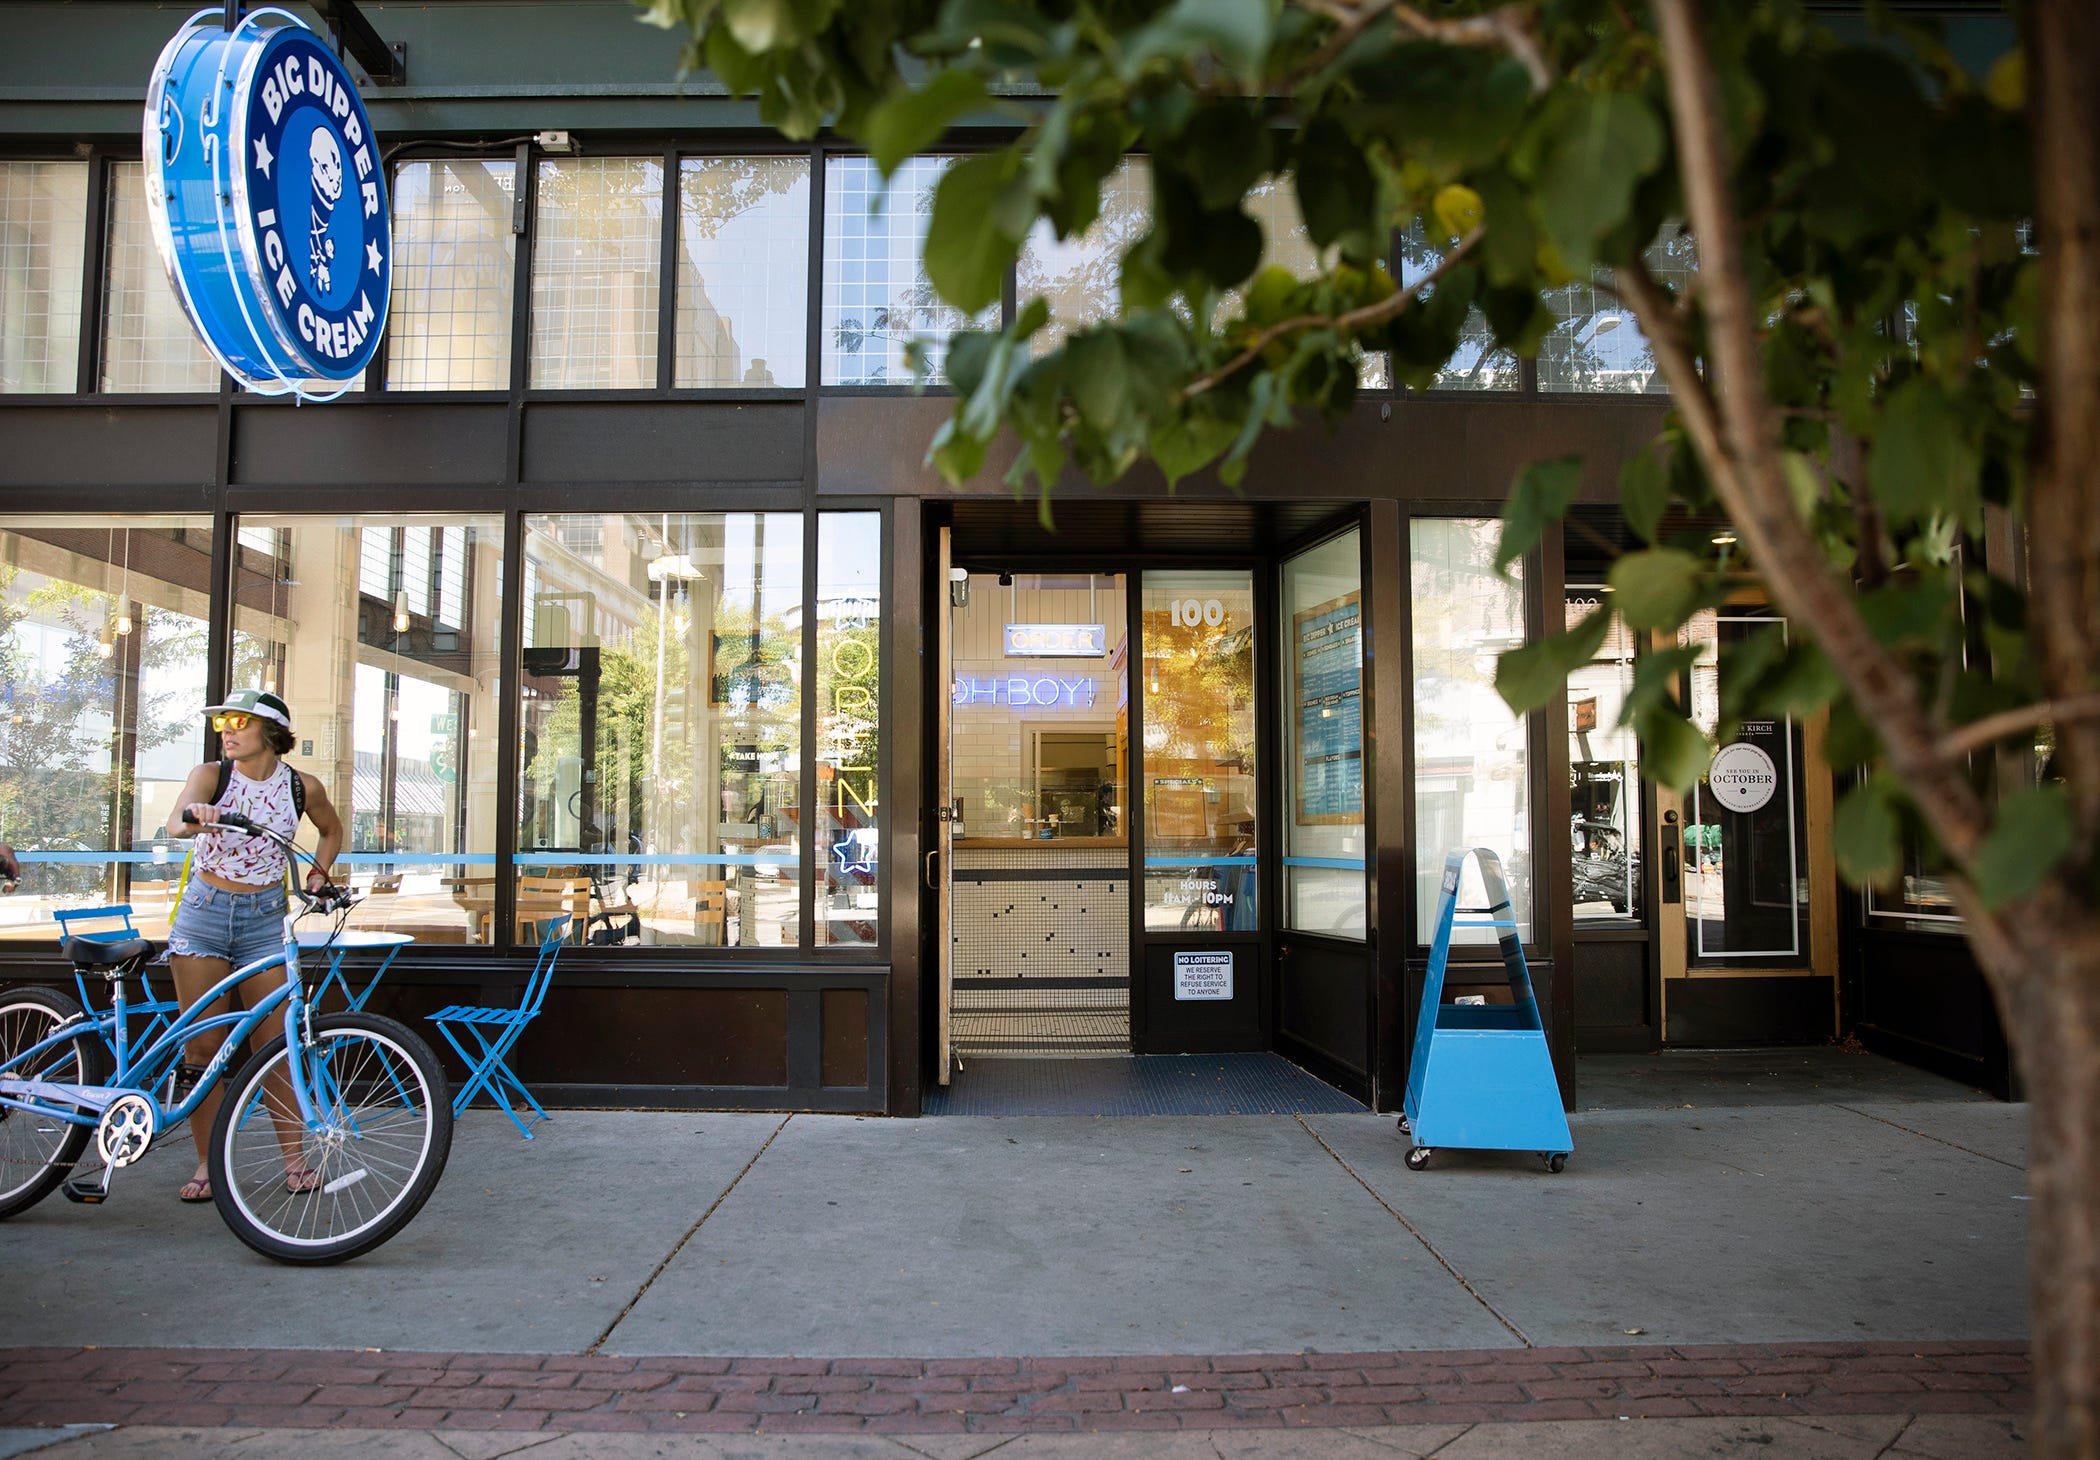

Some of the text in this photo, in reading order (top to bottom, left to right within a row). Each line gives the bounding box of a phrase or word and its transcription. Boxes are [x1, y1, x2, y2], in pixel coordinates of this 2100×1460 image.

[261, 54, 379, 220] BIG DIPPER
[257, 208, 376, 359] ICE CREAM
[1170, 599, 1224, 627] 100
[1335, 620, 1344, 632] ICE
[1344, 615, 1359, 629] CREA
[1011, 632, 1094, 649] ORDER
[1008, 677, 1094, 707] BOY!
[833, 639, 875, 820] OPEN
[735, 752, 755, 760] TAKE
[1713, 774, 1773, 784] OCTOBER
[1180, 880, 1217, 890] HOURS
[1163, 892, 1191, 905] 11AM
[1202, 891, 1234, 905] 10PM
[1178, 956, 1229, 964] NO LOITERING
